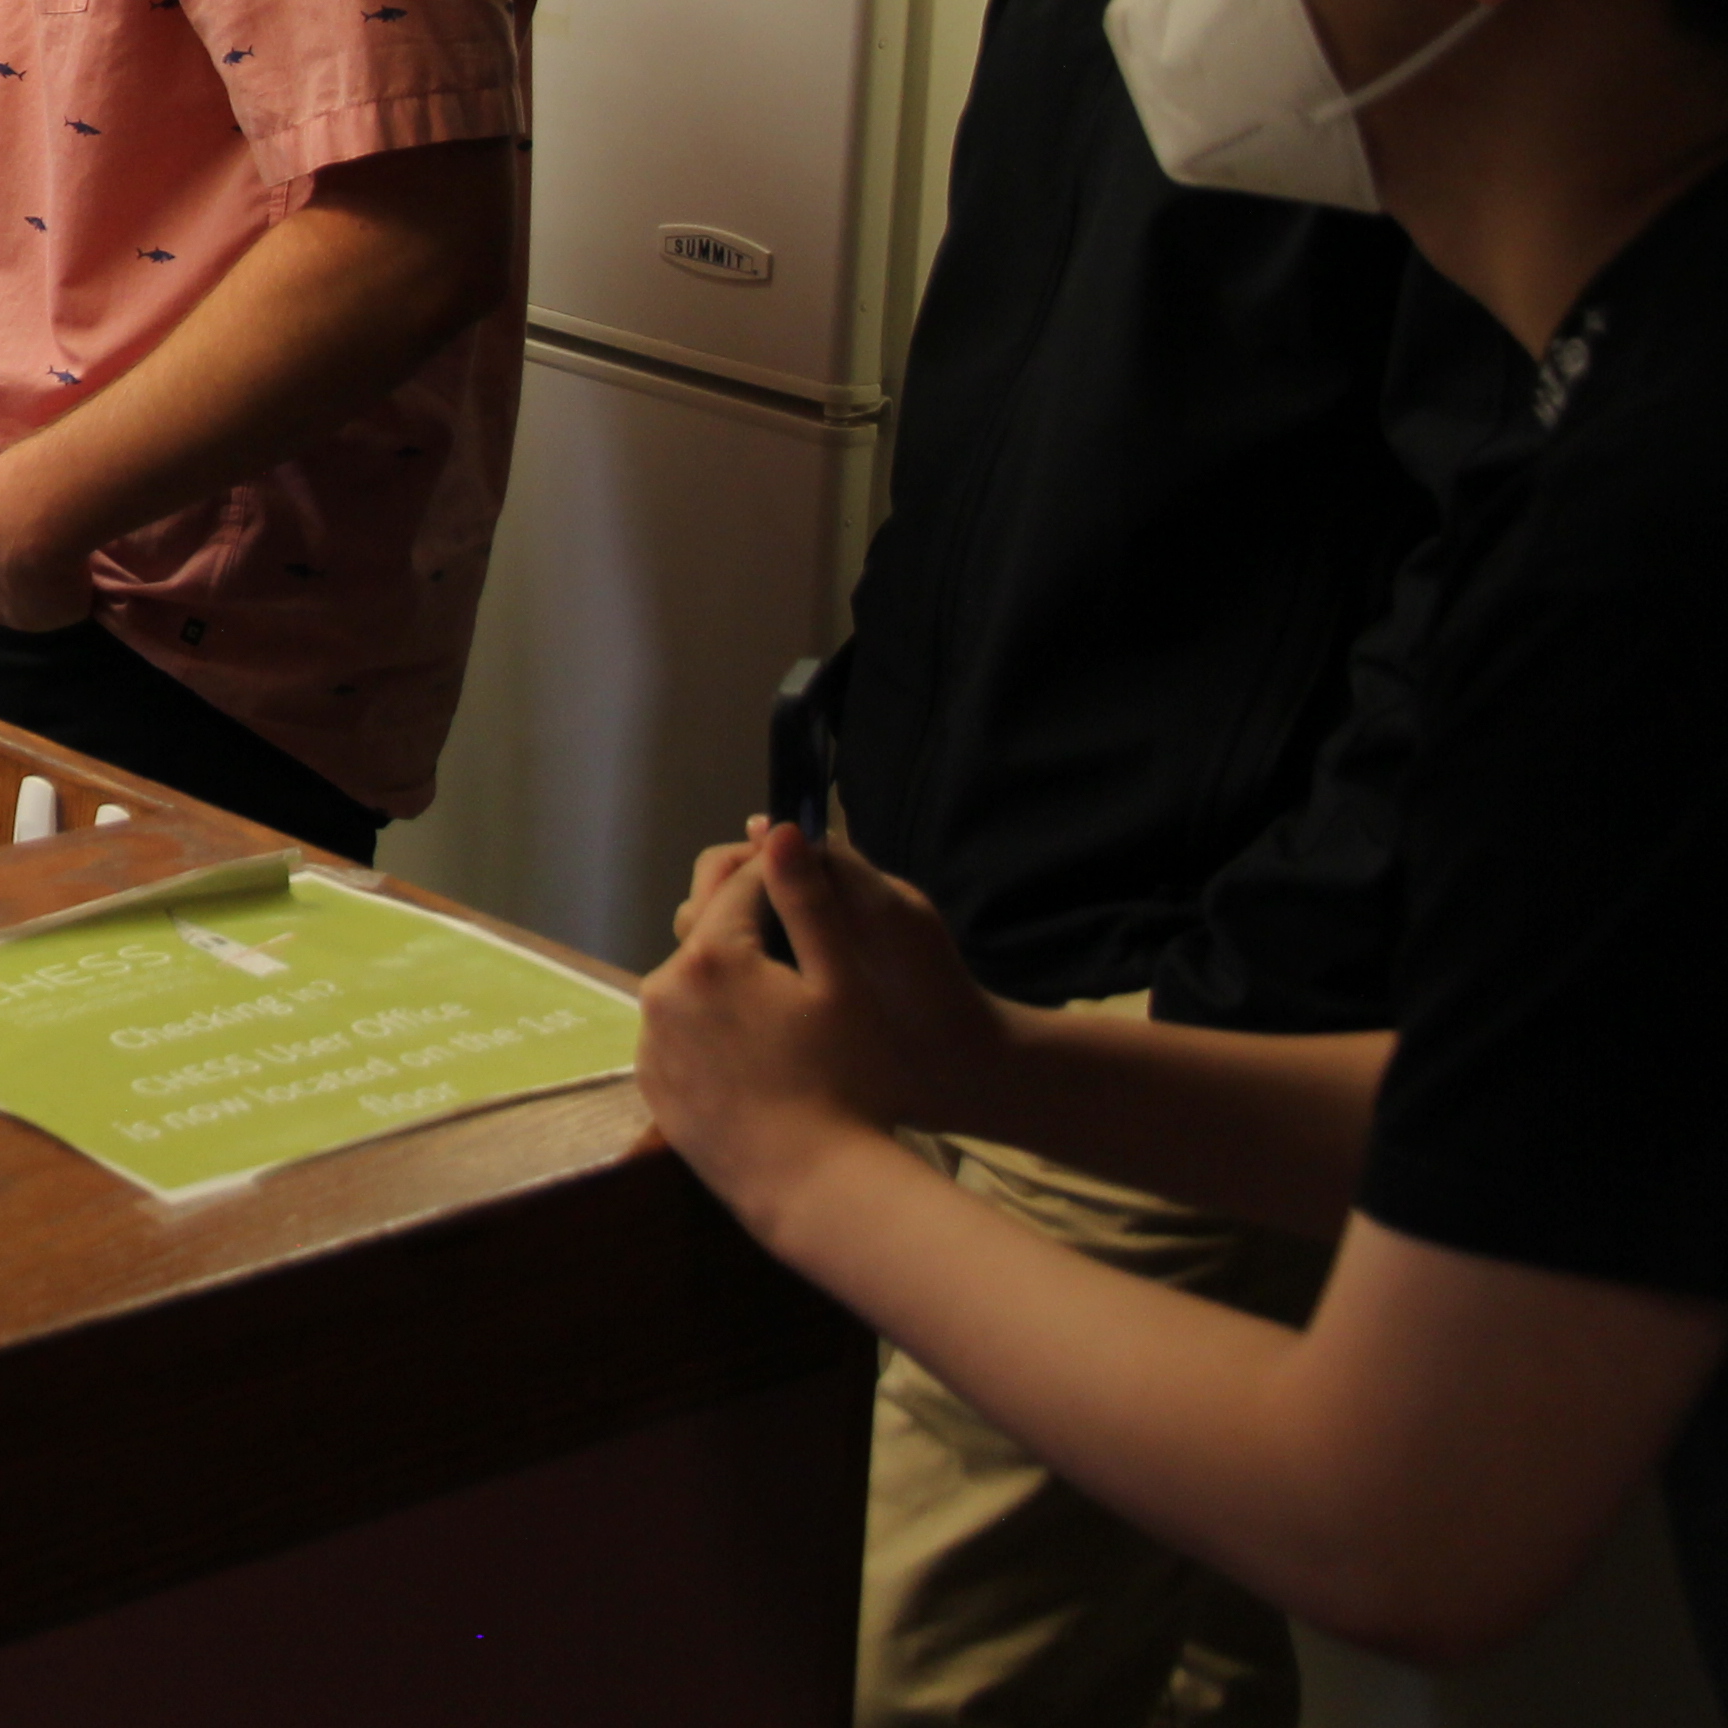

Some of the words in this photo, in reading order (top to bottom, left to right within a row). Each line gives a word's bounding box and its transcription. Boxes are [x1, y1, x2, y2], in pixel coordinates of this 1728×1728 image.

[674, 238, 744, 269] SUMMIT
[109, 993, 294, 1050] Checking
[131, 1052, 262, 1097] CHESS
[255, 1031, 352, 1065] User
[351, 1001, 471, 1039] Office
[111, 1119, 162, 1143] is
[161, 1096, 252, 1131] now
[245, 1055, 399, 1105] located
[399, 1043, 456, 1068] on
[448, 1025, 524, 1055] the
[517, 1007, 588, 1036] 1st
[358, 1079, 460, 1116] floor
